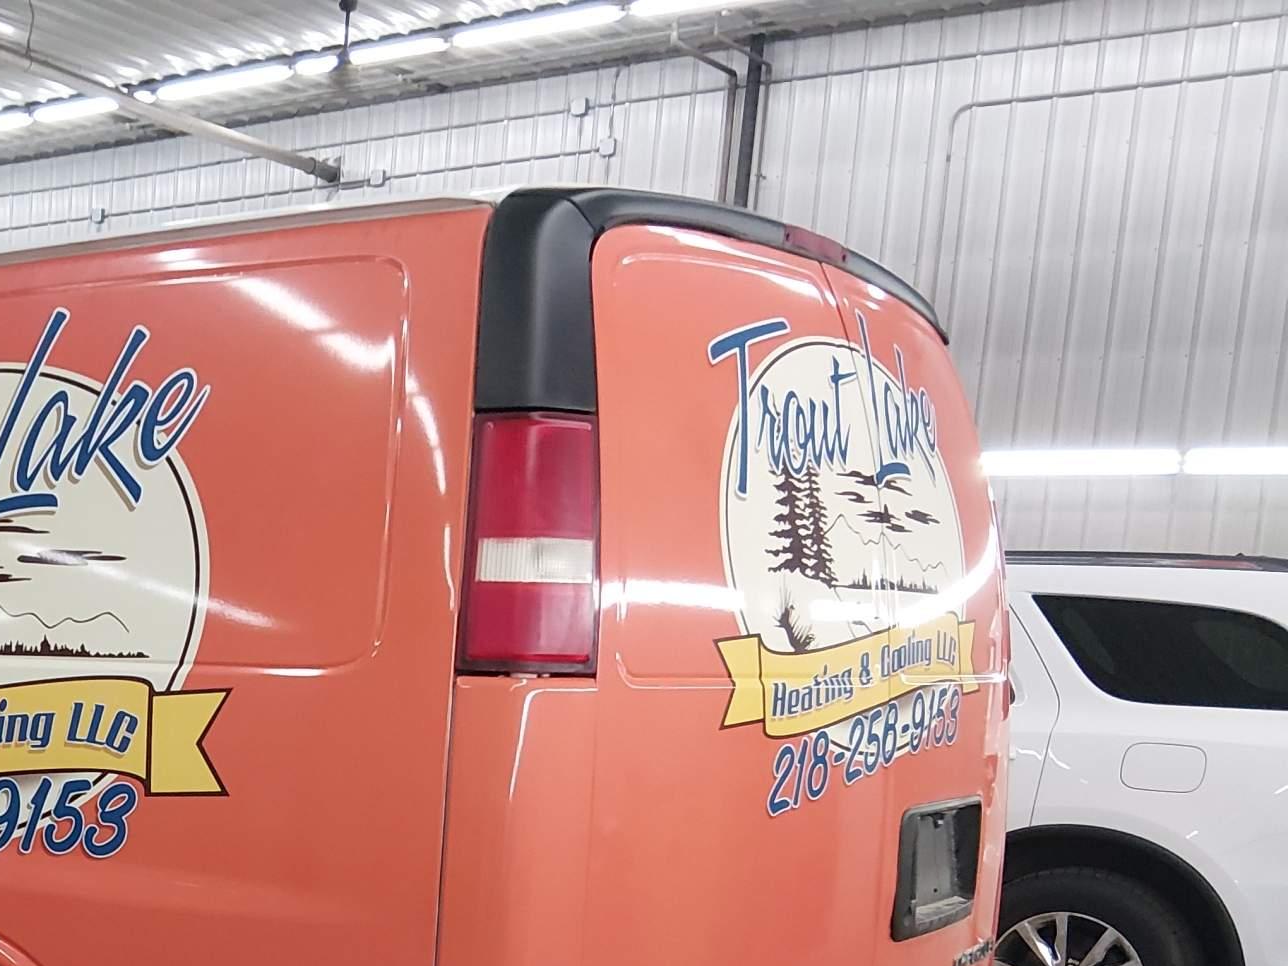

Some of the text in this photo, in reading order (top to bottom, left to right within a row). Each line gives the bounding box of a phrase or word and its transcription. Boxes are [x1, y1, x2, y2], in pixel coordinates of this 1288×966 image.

[708, 310, 936, 497] Trout Lake
[772, 630, 957, 718] Heating & Cooling LLC
[67, 702, 138, 753] LLC
